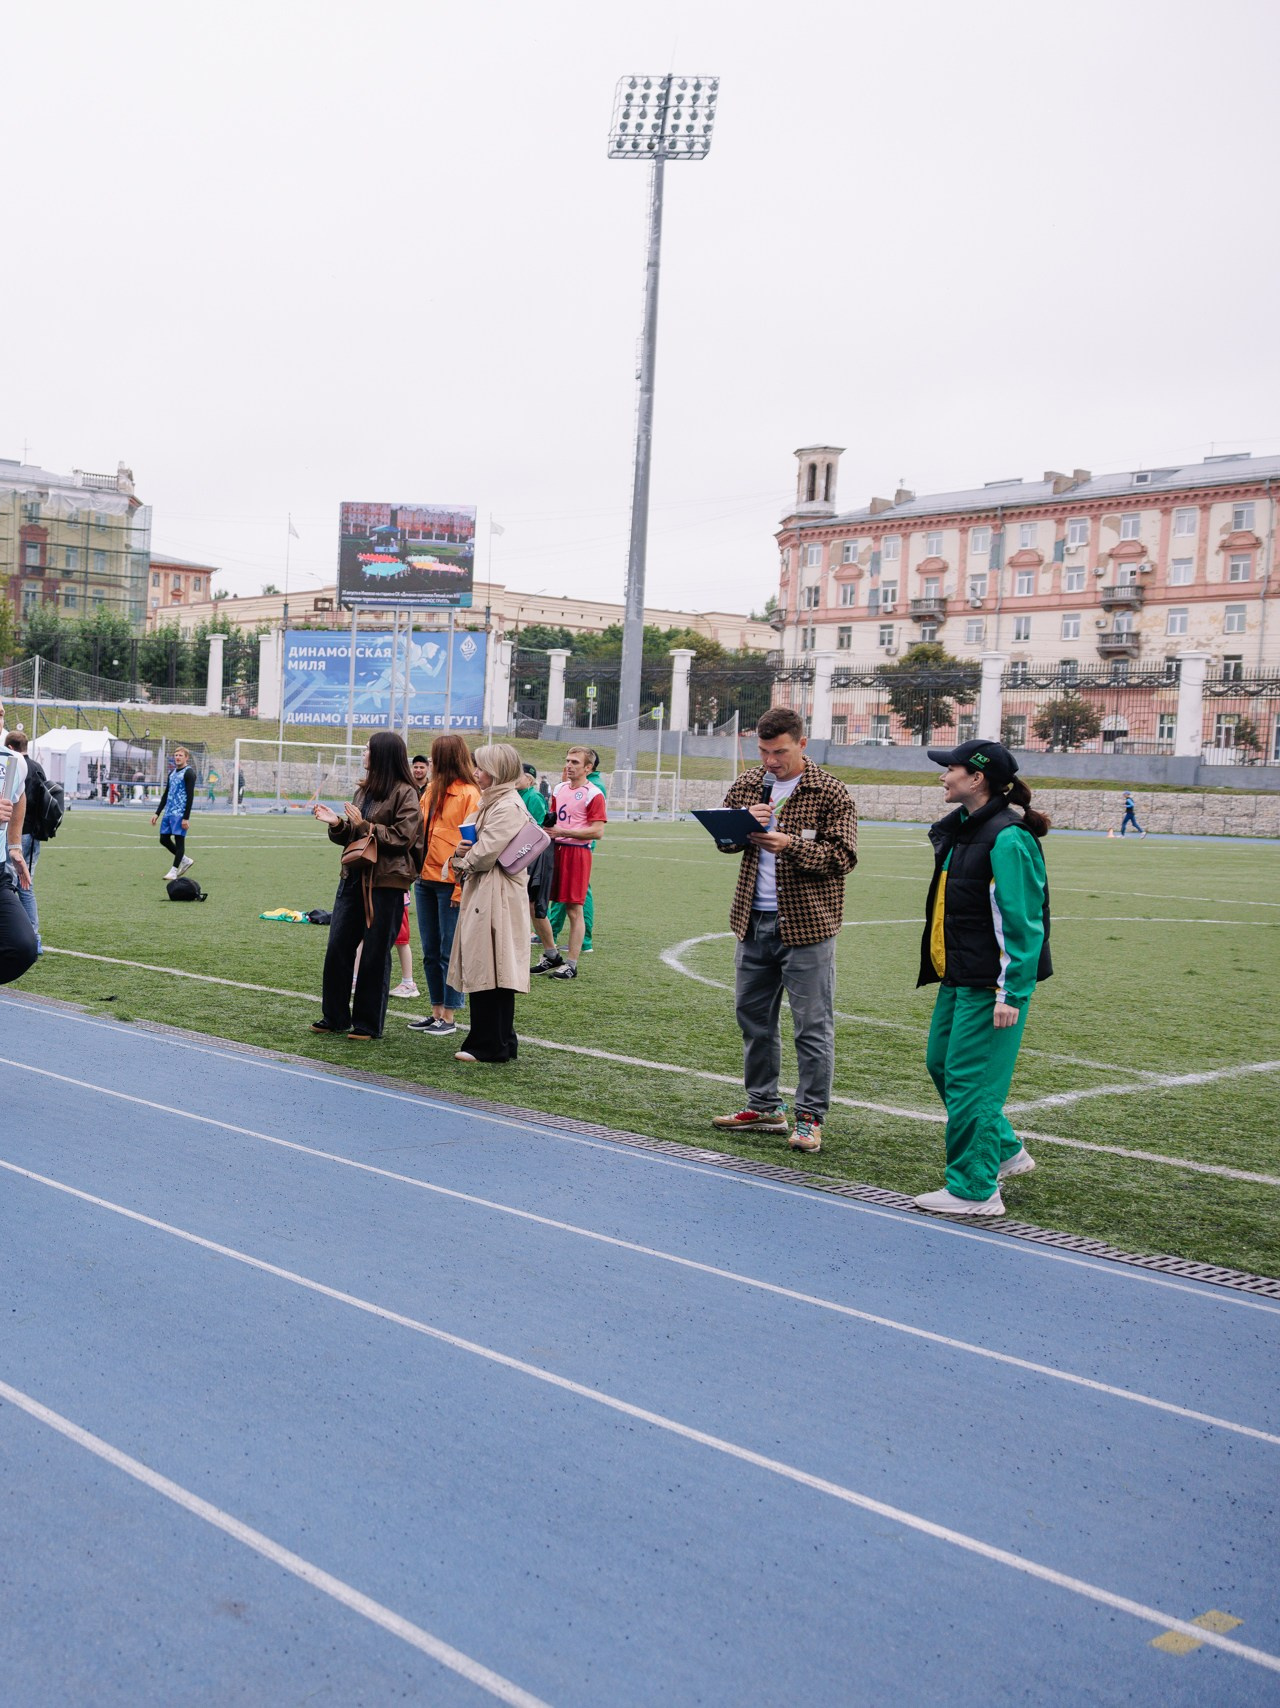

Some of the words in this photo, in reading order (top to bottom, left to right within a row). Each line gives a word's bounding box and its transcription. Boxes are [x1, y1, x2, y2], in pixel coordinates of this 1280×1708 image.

[287, 660, 326, 671] МИЛЯ
[286, 712, 341, 724] ДИНАМО
[407, 714, 430, 725] ВСЕ
